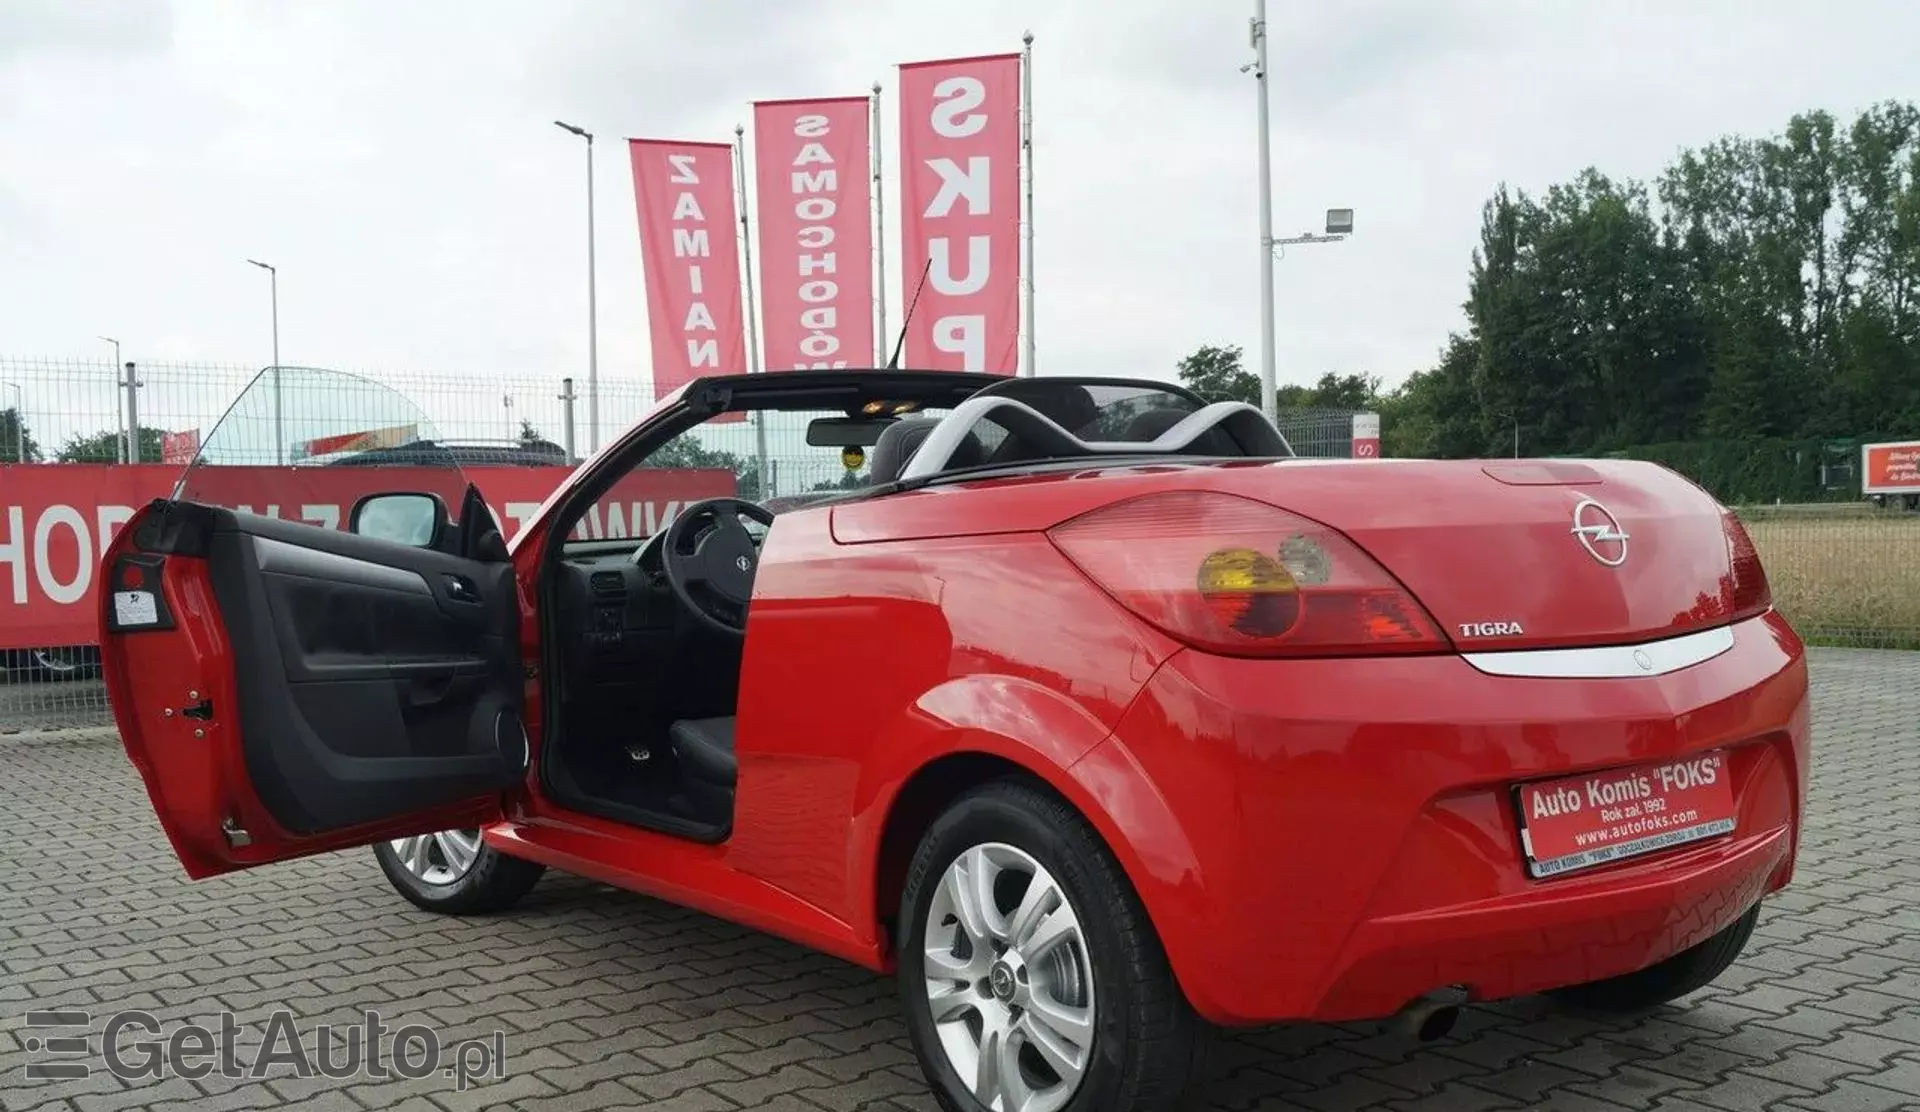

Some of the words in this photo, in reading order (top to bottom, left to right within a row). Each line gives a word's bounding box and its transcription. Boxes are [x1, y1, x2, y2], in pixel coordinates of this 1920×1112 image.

[1458, 621, 1524, 637] TIGRA
[1532, 789, 1582, 819] Auto
[1586, 772, 1651, 808] Komis
[1601, 805, 1623, 823] Rok
[1643, 797, 1667, 814] 1992
[1575, 808, 1698, 846] www.autofoks.com
